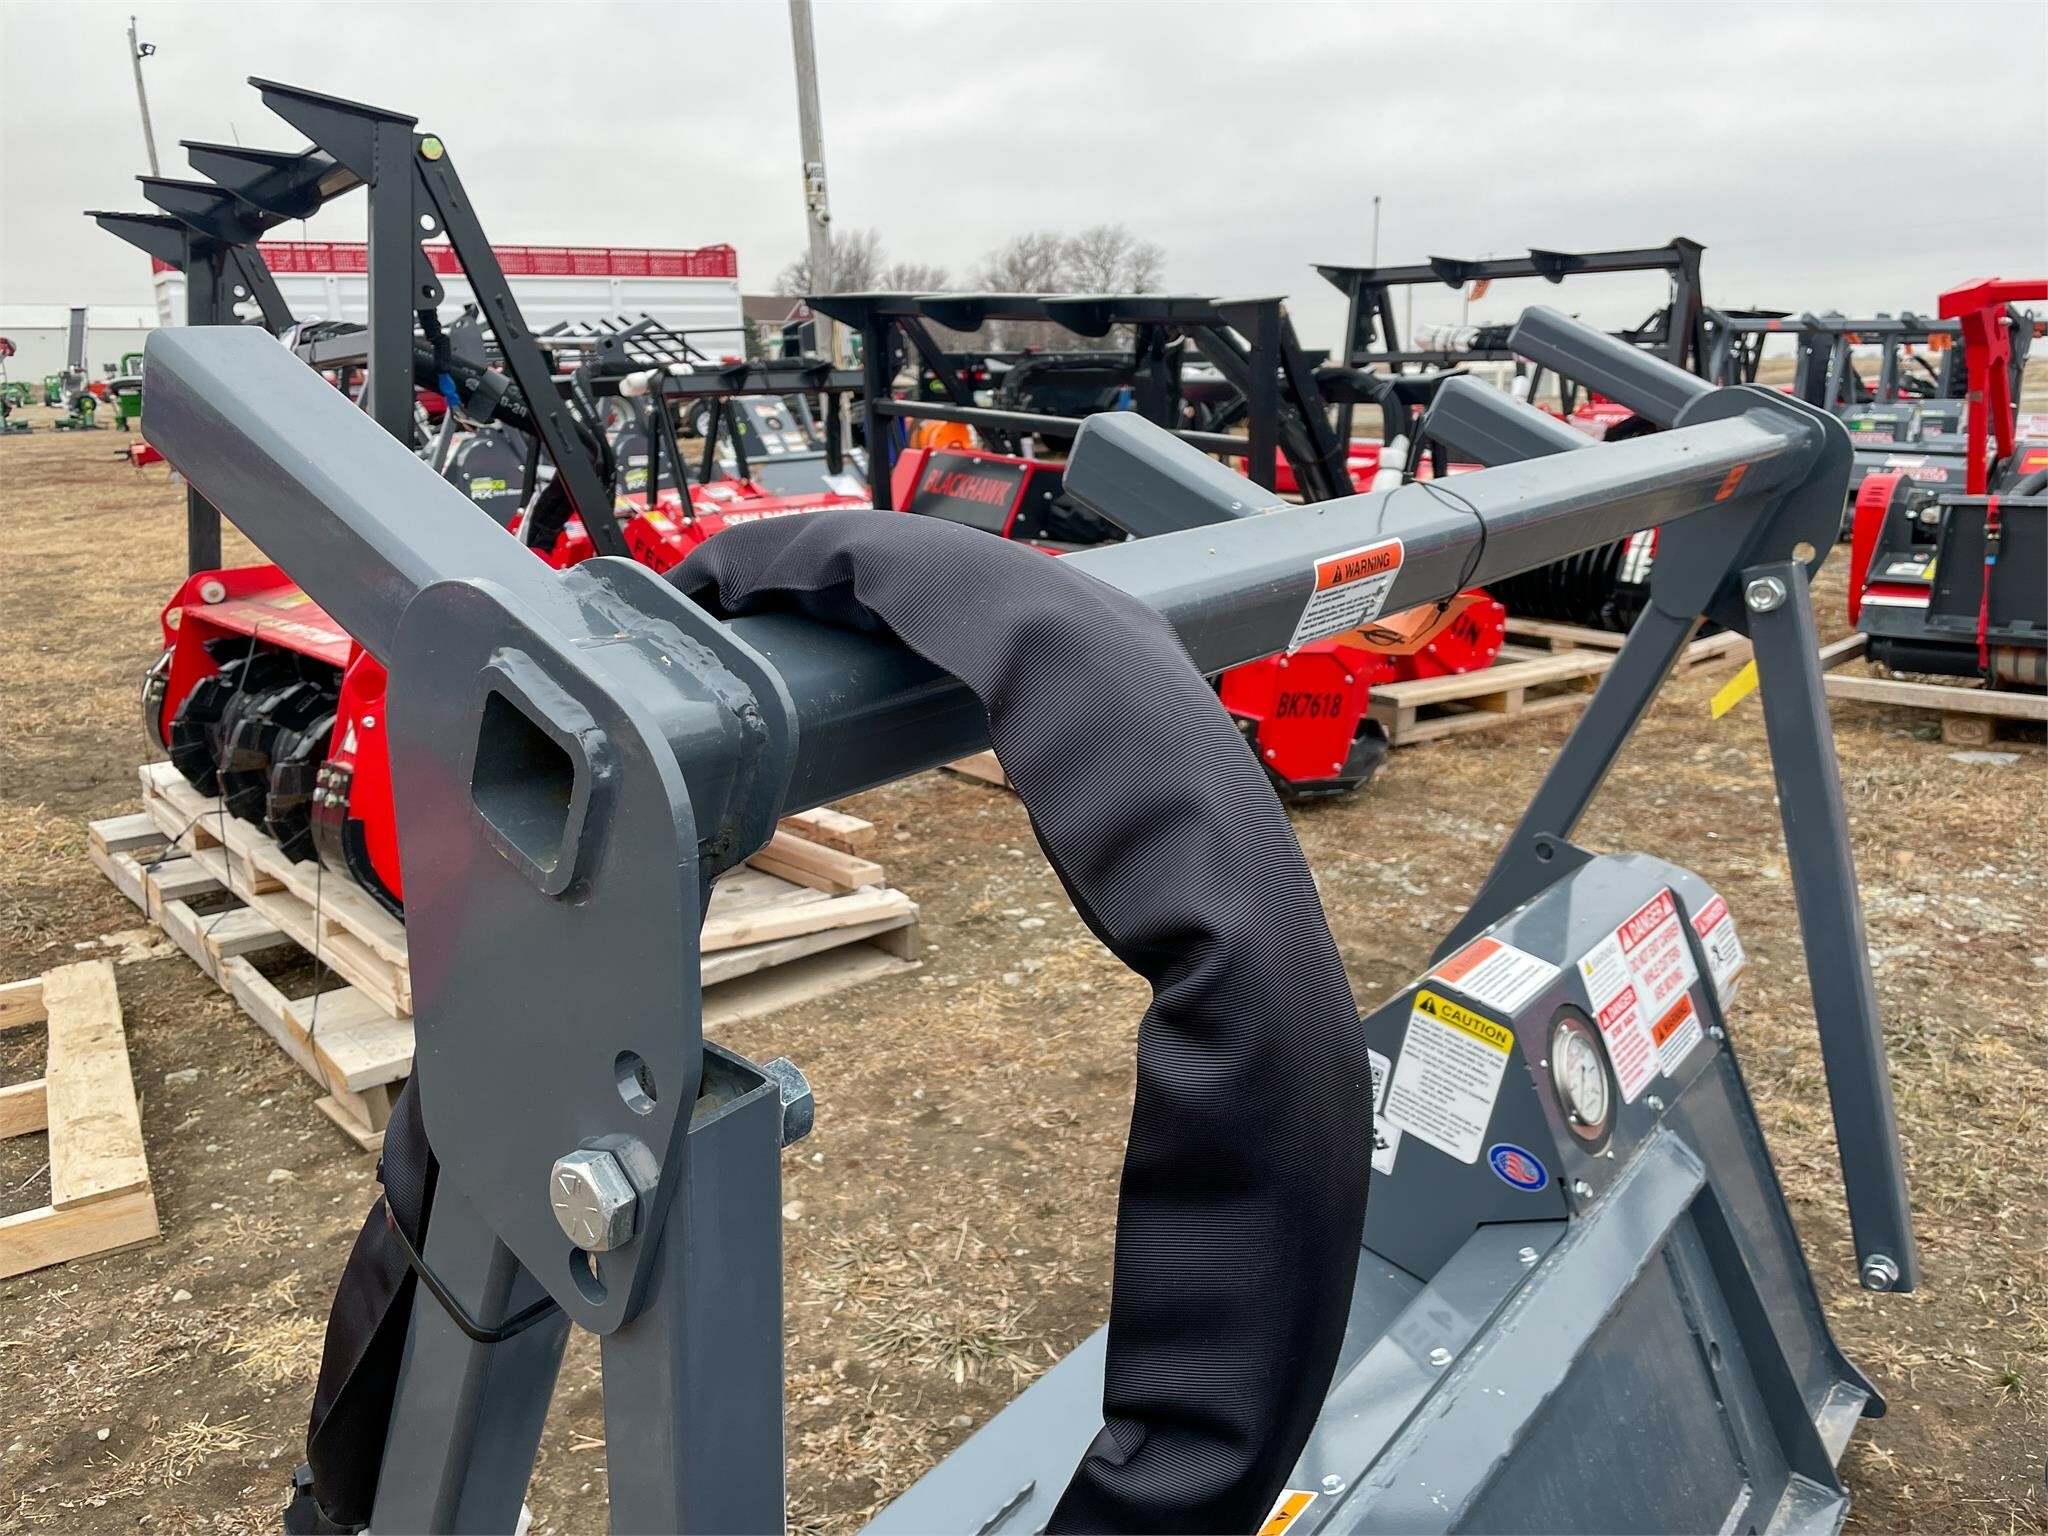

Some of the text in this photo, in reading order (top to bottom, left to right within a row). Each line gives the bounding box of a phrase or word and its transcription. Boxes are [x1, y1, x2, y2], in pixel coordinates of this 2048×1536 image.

[923, 469, 1013, 506] BLACKHAWK
[1344, 552, 1390, 580] WARNING
[1276, 692, 1343, 719] BK7618
[1628, 901, 1663, 944] DANGER
[1440, 1003, 1508, 1044] CAUTION
